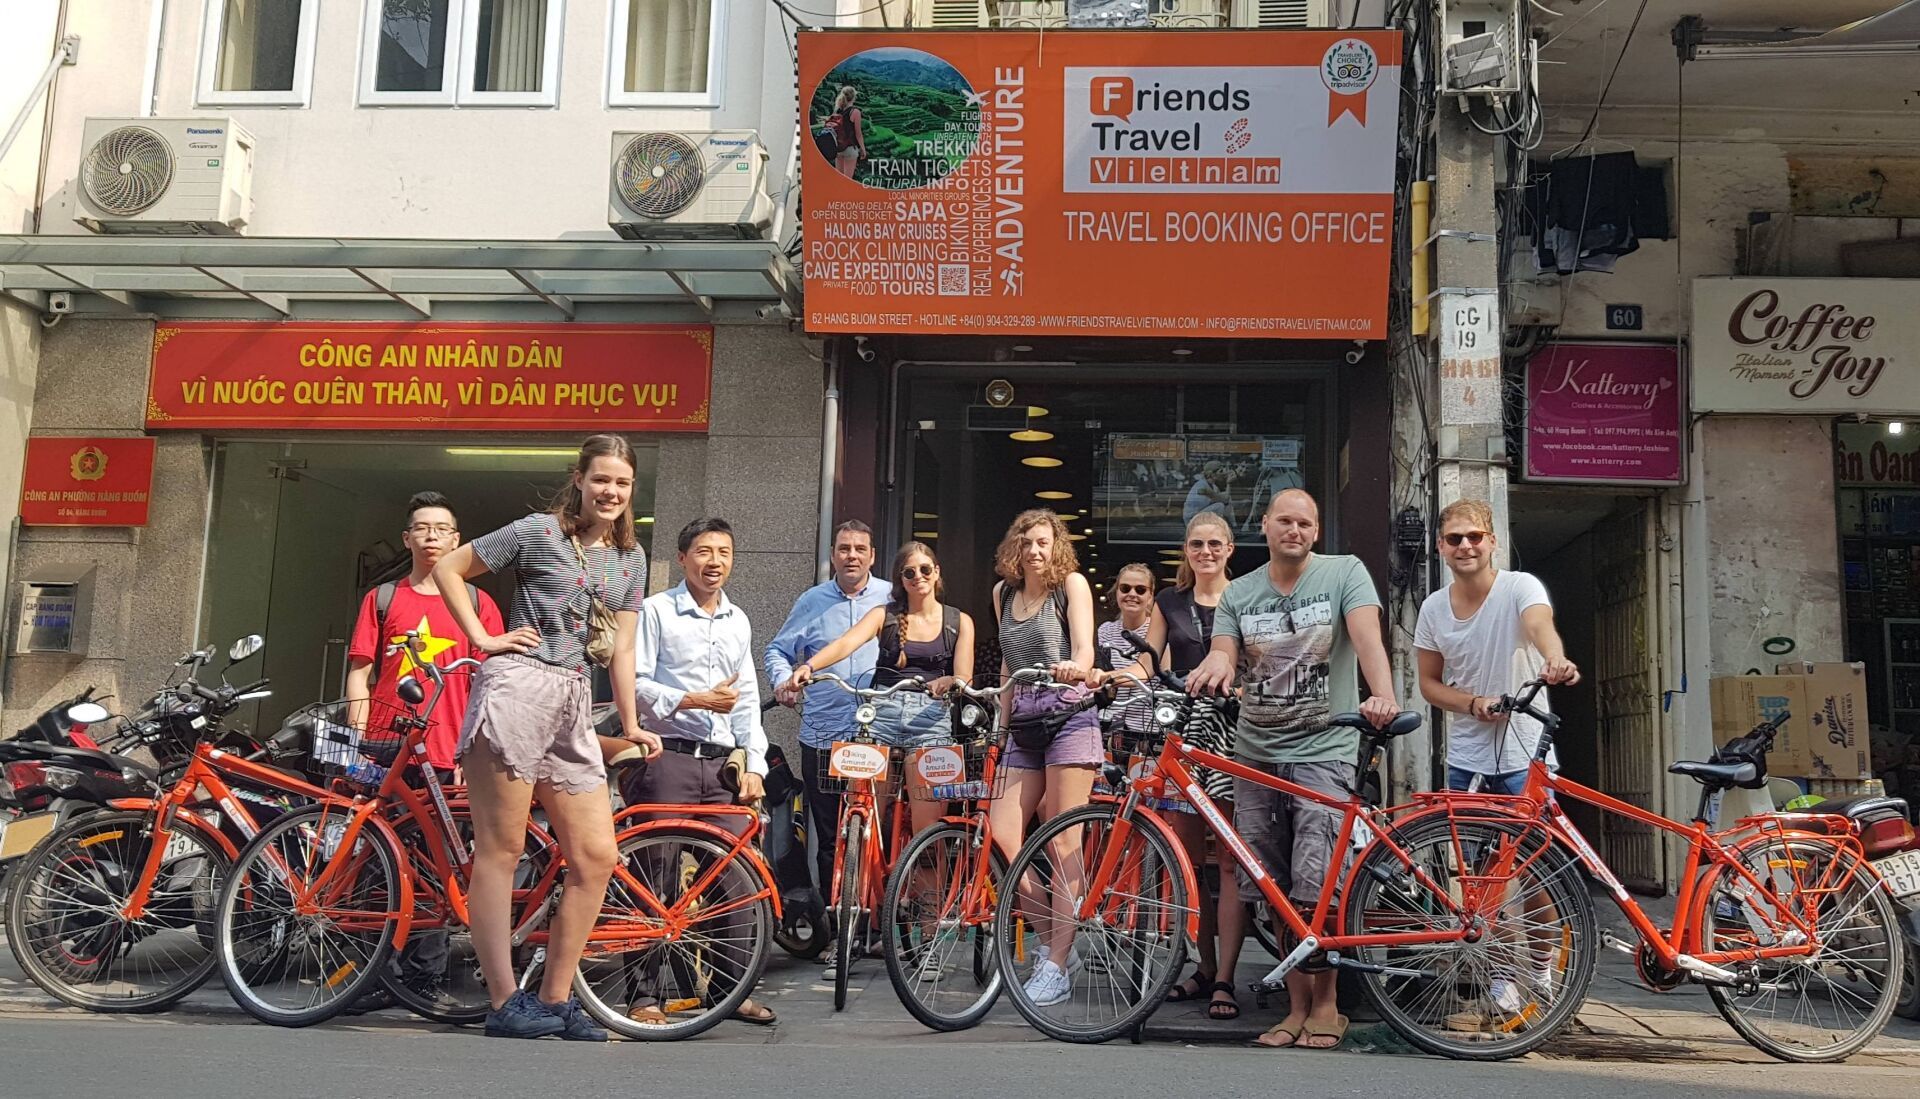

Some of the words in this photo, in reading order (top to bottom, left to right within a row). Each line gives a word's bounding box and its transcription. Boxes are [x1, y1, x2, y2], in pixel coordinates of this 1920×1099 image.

[1103, 81, 1251, 112] Friends
[961, 111, 992, 121] FLIGHTS
[933, 132, 972, 141] UNBEATEN
[973, 132, 992, 141] PATH
[944, 122, 961, 132] DAY
[963, 122, 992, 132] TOURS
[1091, 121, 1201, 151] Travel
[913, 140, 993, 156] TREKKING
[867, 158, 918, 176] TRAIN
[921, 159, 992, 177] TICKETS
[995, 66, 1024, 263] ADVENTURE
[1095, 159, 1280, 183] Vietnam
[862, 178, 922, 190] CULTURAL
[926, 178, 969, 190] INFO
[827, 201, 865, 210] MEKONG
[866, 202, 893, 211] DELTA
[888, 192, 907, 201] LOCAL
[908, 192, 944, 201] MINORITIES
[944, 192, 971, 201] GROUPS
[811, 210, 838, 220] OPEN
[840, 211, 858, 220] BUS
[860, 211, 893, 220] TICKET
[895, 201, 948, 221] SAPA
[973, 178, 992, 263] EXPERIENCES
[824, 222, 871, 240] HALONG
[874, 223, 896, 240] BAY
[899, 223, 947, 240] CRUISES
[949, 202, 970, 262] BIKING
[1063, 211, 1158, 242] TRAVEL
[1165, 211, 1283, 243] BOOKING
[1290, 212, 1385, 244] OFFICE
[811, 241, 861, 260] ROCK
[865, 242, 948, 261] CLIMBING
[804, 261, 840, 279] CAVE
[844, 262, 935, 281] EXPEDITIONS
[823, 281, 849, 289] PRIVATE
[850, 281, 877, 296] FOOD
[880, 281, 935, 296] TOURS
[973, 266, 992, 297] REAL
[812, 312, 822, 324] 62
[824, 313, 849, 325] HANG
[851, 314, 877, 326] BUOM
[878, 314, 913, 326] STREET
[919, 315, 957, 327] HOTLINE
[959, 315, 985, 328] +84(0)
[986, 315, 1036, 328] 904-329-289
[1205, 318, 1372, 331] INFO@FRIENDSTRAVELVIETNAM.COM
[1456, 306, 1481, 327] CG
[1613, 309, 1636, 327] 60
[1728, 289, 1875, 351] Coffee
[1458, 330, 1476, 350] 19
[300, 339, 372, 368] CÔNG
[379, 345, 416, 368] AN
[425, 339, 499, 368] NHÂN
[506, 340, 563, 368] DÂN
[1736, 353, 1792, 366] Italian
[1729, 366, 1795, 383] Moment
[1789, 345, 1885, 398] Joy
[181, 376, 207, 404] VÌ
[212, 375, 286, 404] NƯỚC
[293, 376, 365, 405] QUÊN
[372, 376, 449, 409] THÂN,
[457, 376, 484, 405] VÌ
[490, 377, 546, 406] DÂN
[554, 383, 625, 414] PHỤC
[632, 383, 678, 414] VỤ!
[1541, 360, 1659, 409] Katterry
[1571, 457, 1642, 466] www.katterry.com
[24, 490, 47, 501] CÔNG
[49, 491, 60, 501] AN
[1241, 606, 1260, 615] LIVE
[1264, 603, 1277, 613] ON
[1301, 592, 1330, 608] BEACH
[1823, 696, 1847, 749] Danisa
